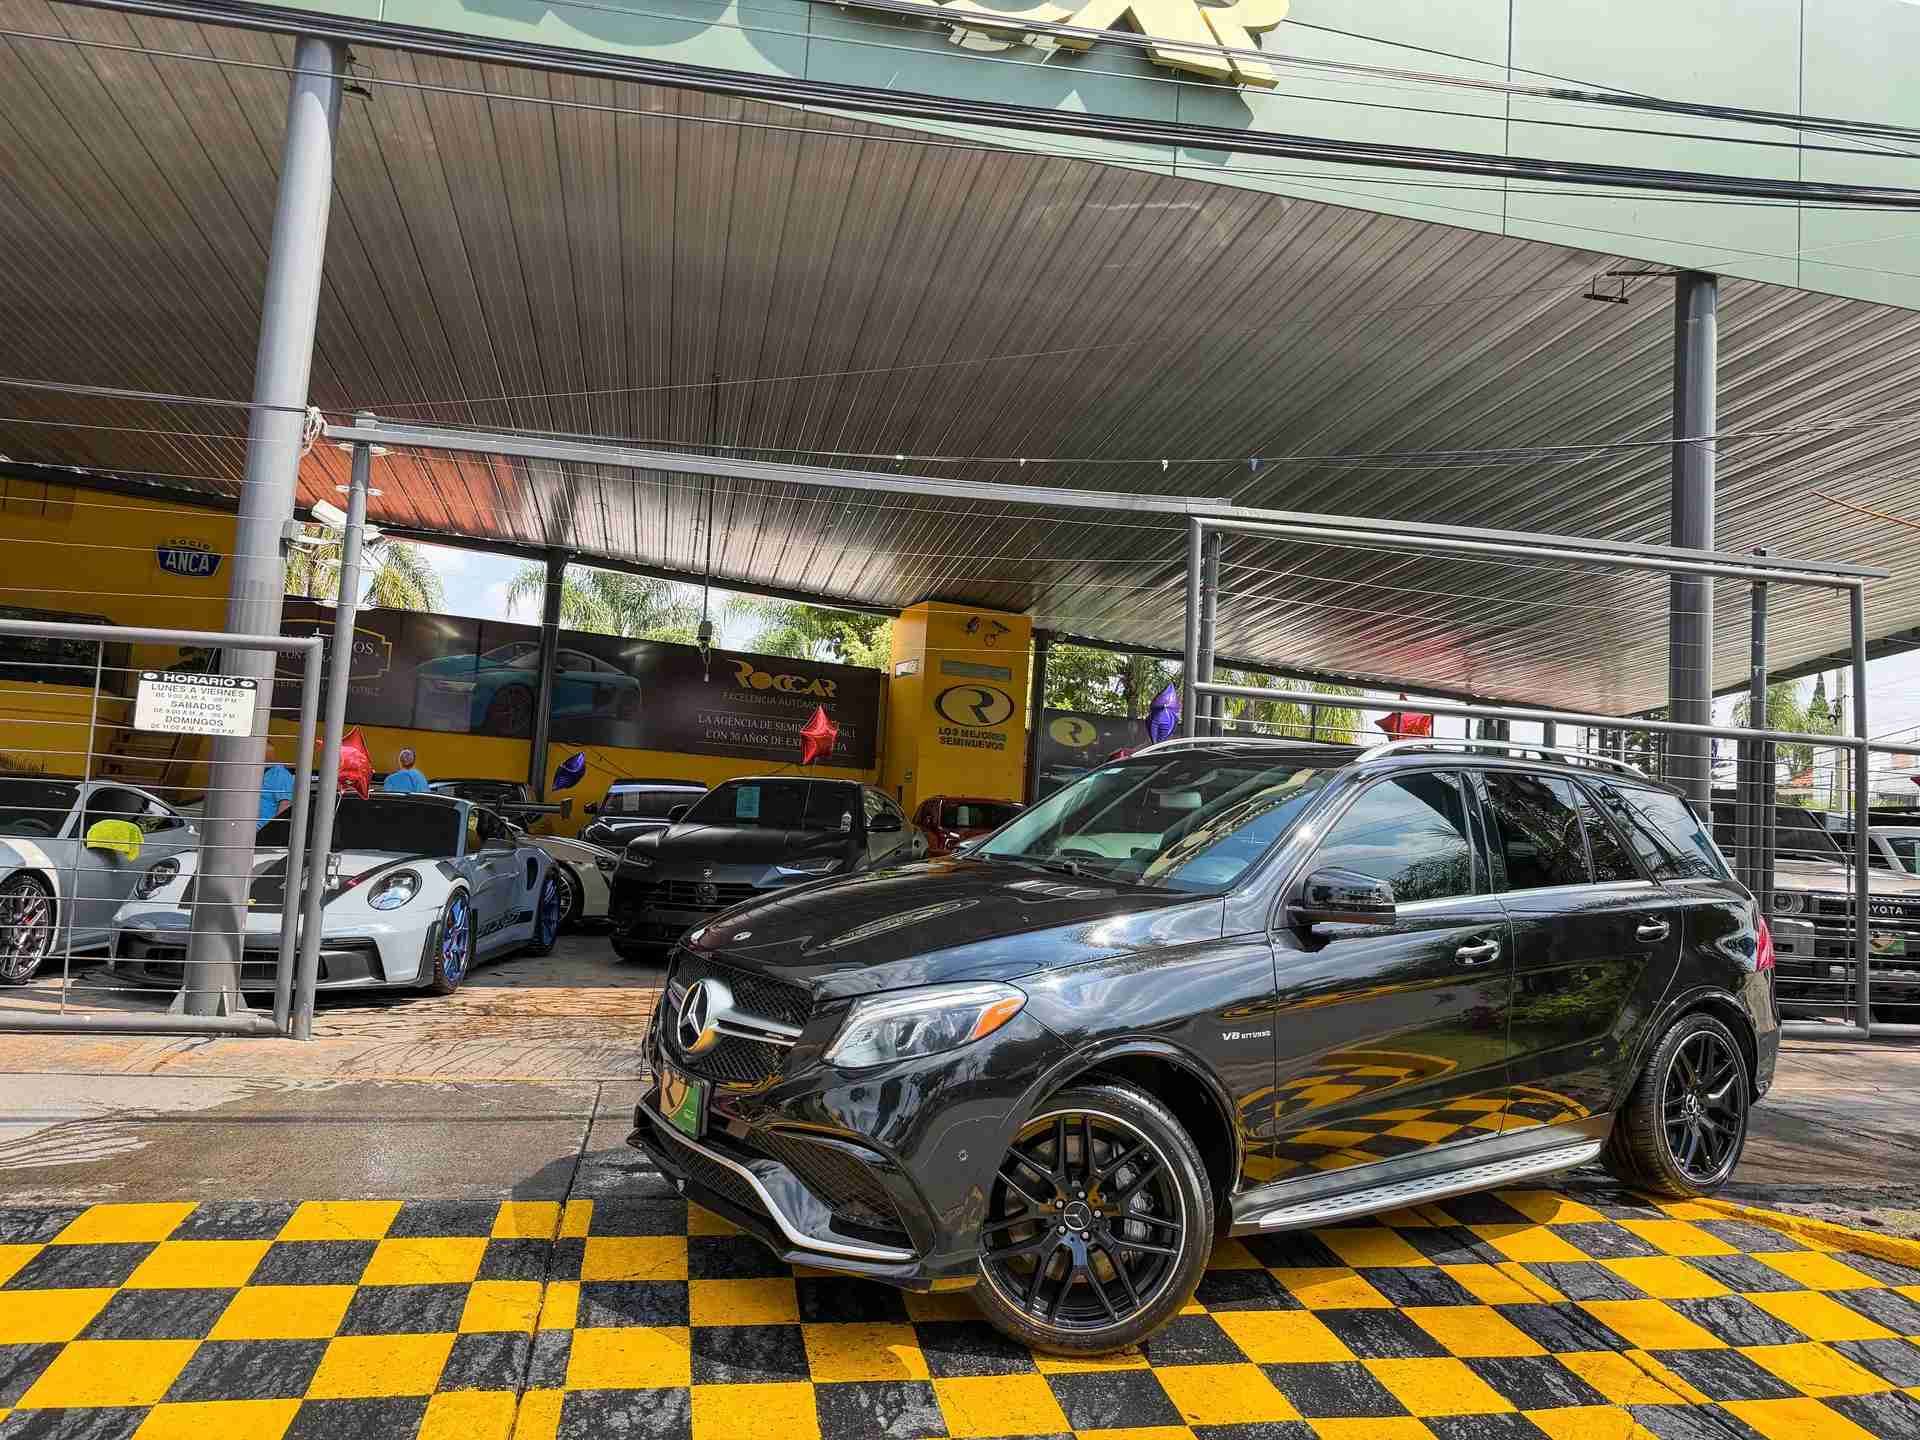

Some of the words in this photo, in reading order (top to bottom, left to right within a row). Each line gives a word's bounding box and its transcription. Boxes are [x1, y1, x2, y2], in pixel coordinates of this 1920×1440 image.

[166, 551, 209, 572] ANCA
[163, 673, 236, 687] HORARIO
[727, 657, 838, 697] ROCCAR
[151, 683, 186, 692] LUNES
[200, 687, 245, 697] VIERNES
[166, 715, 224, 727] DOMINGOS
[698, 714, 712, 724] LA
[714, 716, 758, 729] AGENCIA
[760, 720, 771, 729] DE
[705, 728, 727, 741] CON
[743, 732, 768, 745] AÑOS
[771, 735, 784, 745] DE
[938, 727, 958, 736] LOS
[960, 728, 1007, 741] MEJORES
[938, 736, 1006, 751] SEMINUEVOS
[1868, 905, 1904, 916] YOTA
[1222, 1031, 1240, 1041] V8
